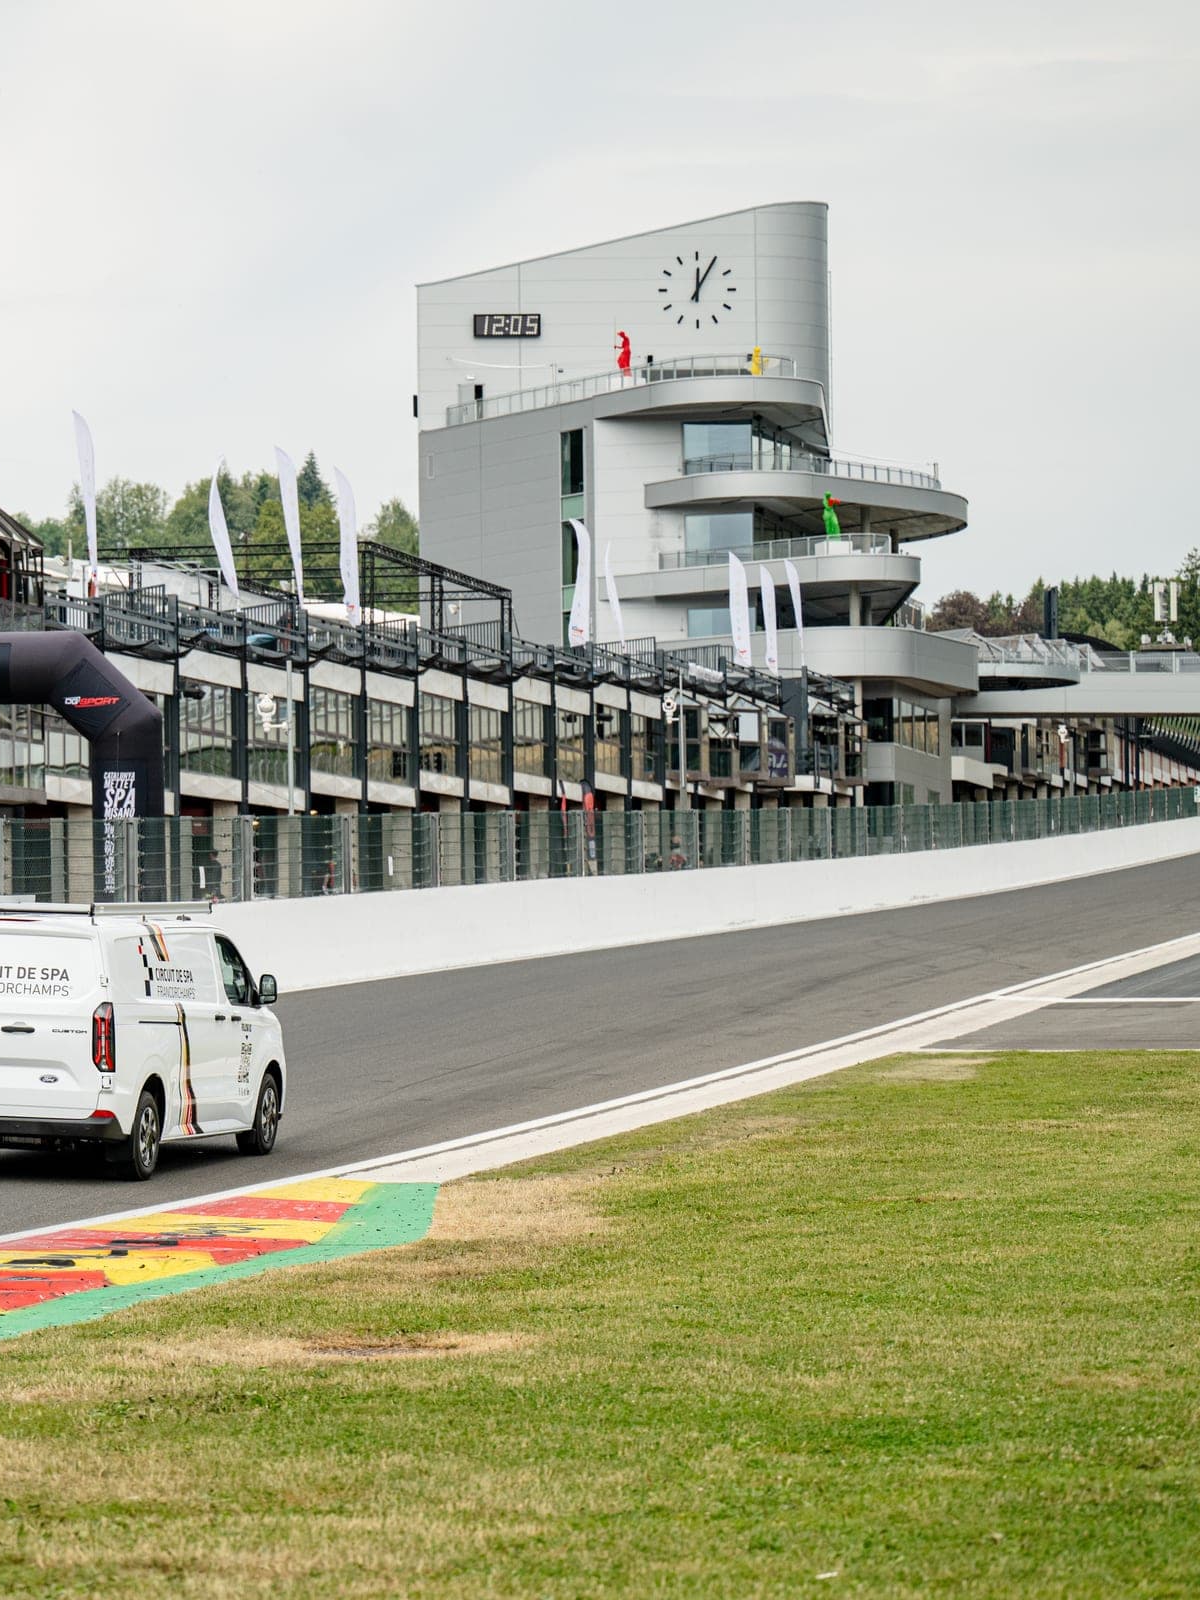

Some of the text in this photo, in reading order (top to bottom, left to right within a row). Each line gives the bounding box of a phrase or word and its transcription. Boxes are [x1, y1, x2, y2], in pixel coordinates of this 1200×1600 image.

[483, 315, 539, 335] 12:05
[103, 779, 135, 789] METTET
[103, 788, 136, 808] SPA
[104, 807, 136, 818] MISANO
[16, 966, 37, 980] DE
[40, 967, 69, 981] SPA
[155, 968, 194, 983] CIRCUIT DE SPA
[156, 985, 196, 1000] FRANCORCHAMPS
